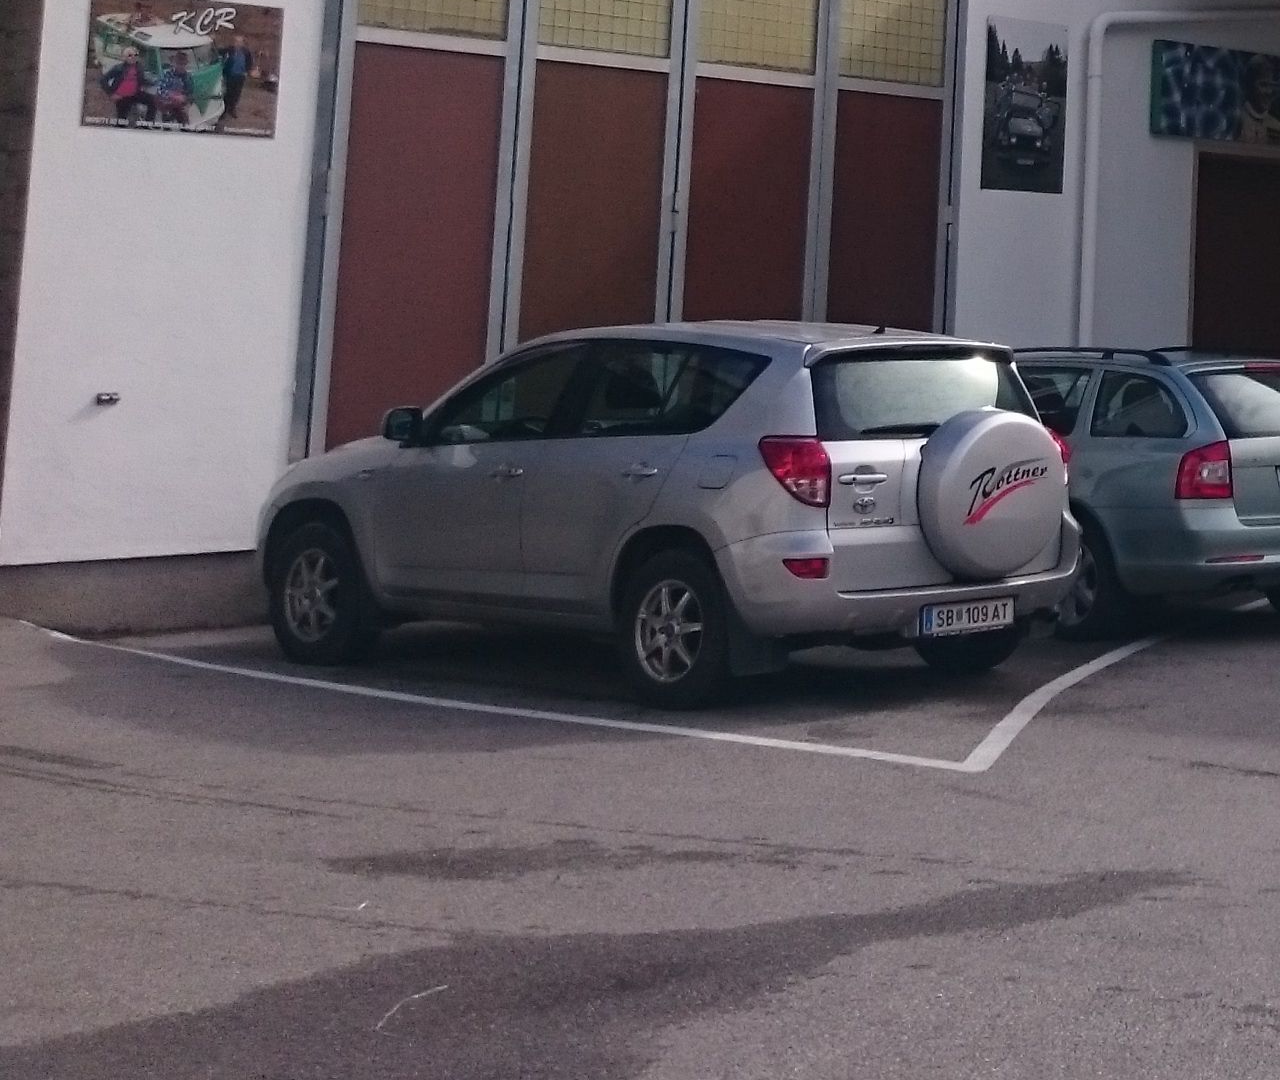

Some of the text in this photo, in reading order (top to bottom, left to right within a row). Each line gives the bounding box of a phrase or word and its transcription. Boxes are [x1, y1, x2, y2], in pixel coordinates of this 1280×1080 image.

[171, 7, 237, 37] KCR
[967, 466, 1048, 517] Rottner
[936, 602, 1010, 628] SB 109 AT
